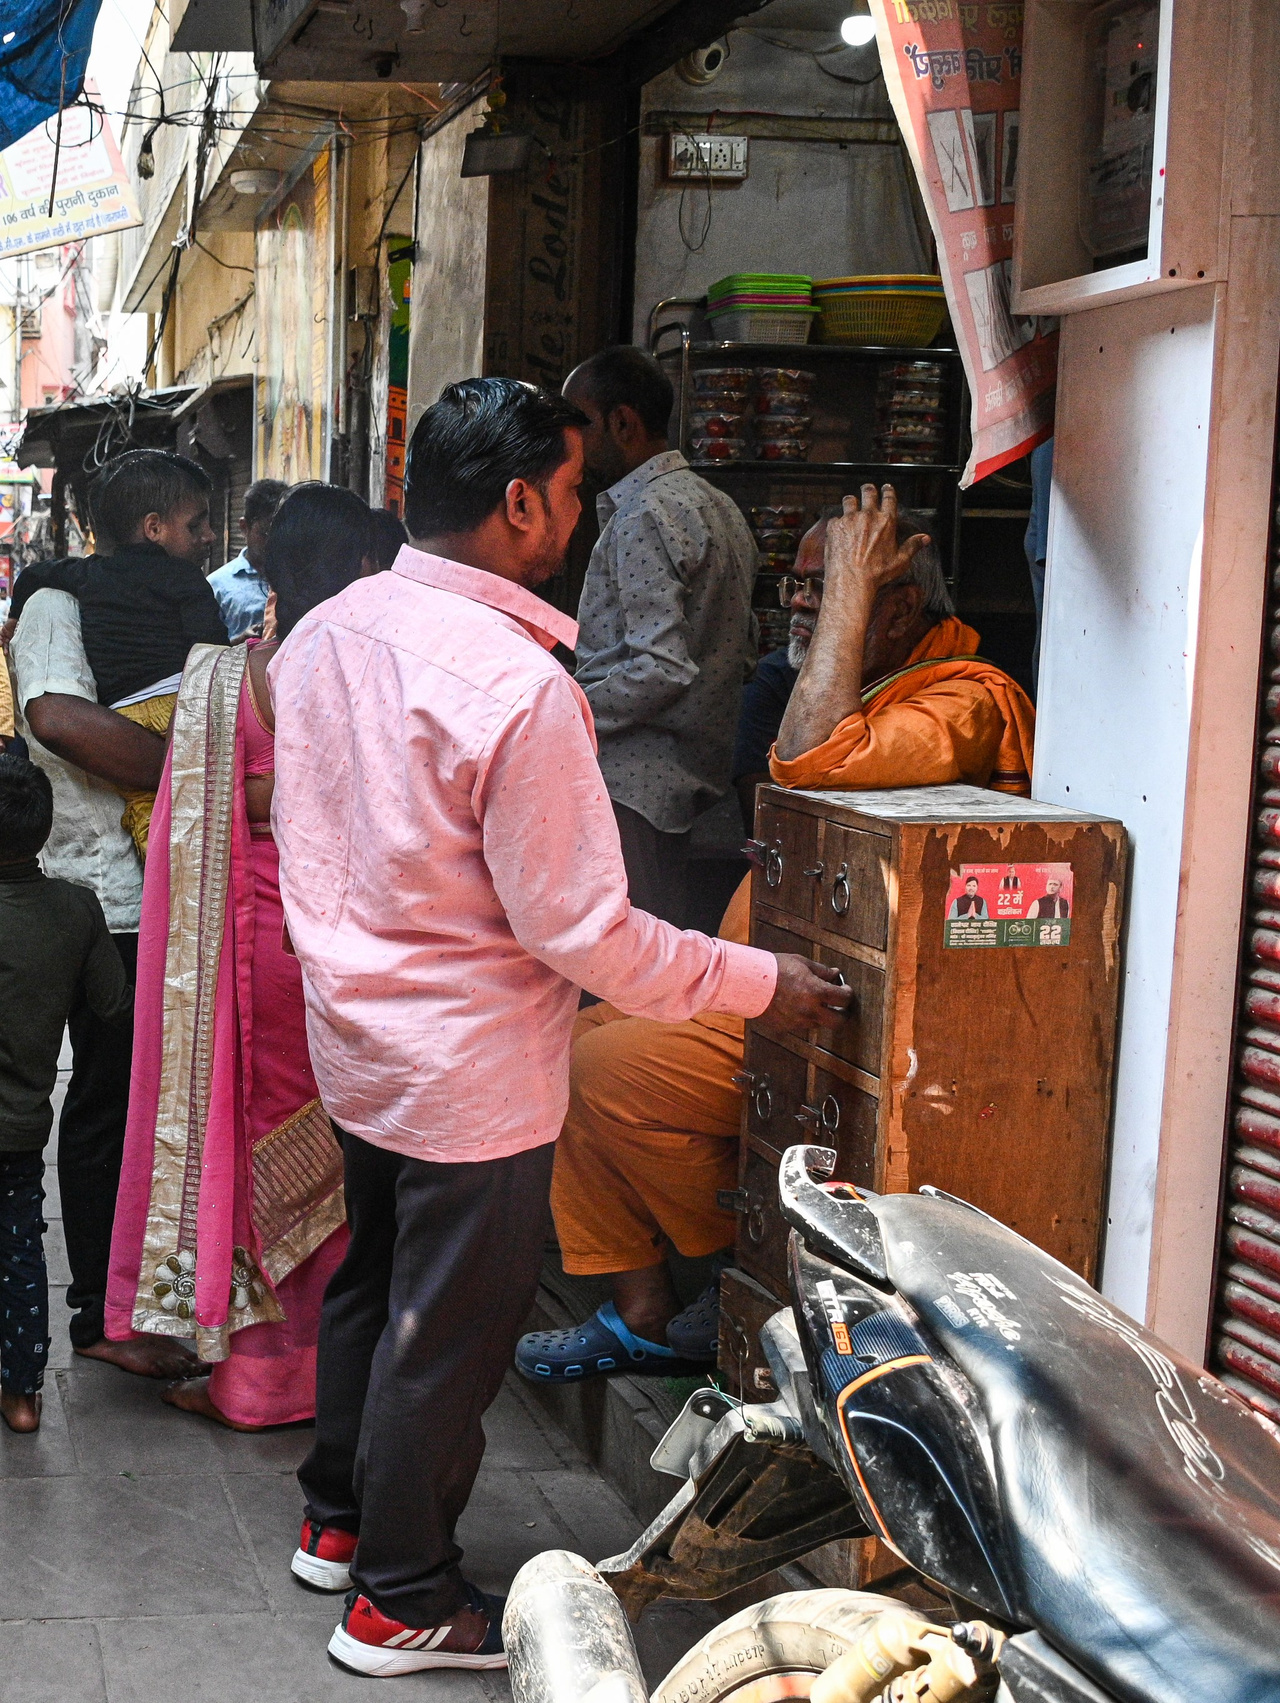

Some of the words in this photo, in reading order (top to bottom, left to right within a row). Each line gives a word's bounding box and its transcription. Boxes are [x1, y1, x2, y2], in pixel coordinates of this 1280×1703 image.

[20, 203, 36, 220] वर्ष
[55, 190, 85, 216] पुरानी
[88, 185, 119, 208] दुकान
[997, 894, 1010, 905] 22
[1013, 891, 1024, 905] में
[1039, 925, 1062, 939] 22
[966, 1308, 989, 1328] RTR
[833, 1326, 850, 1352] 160
